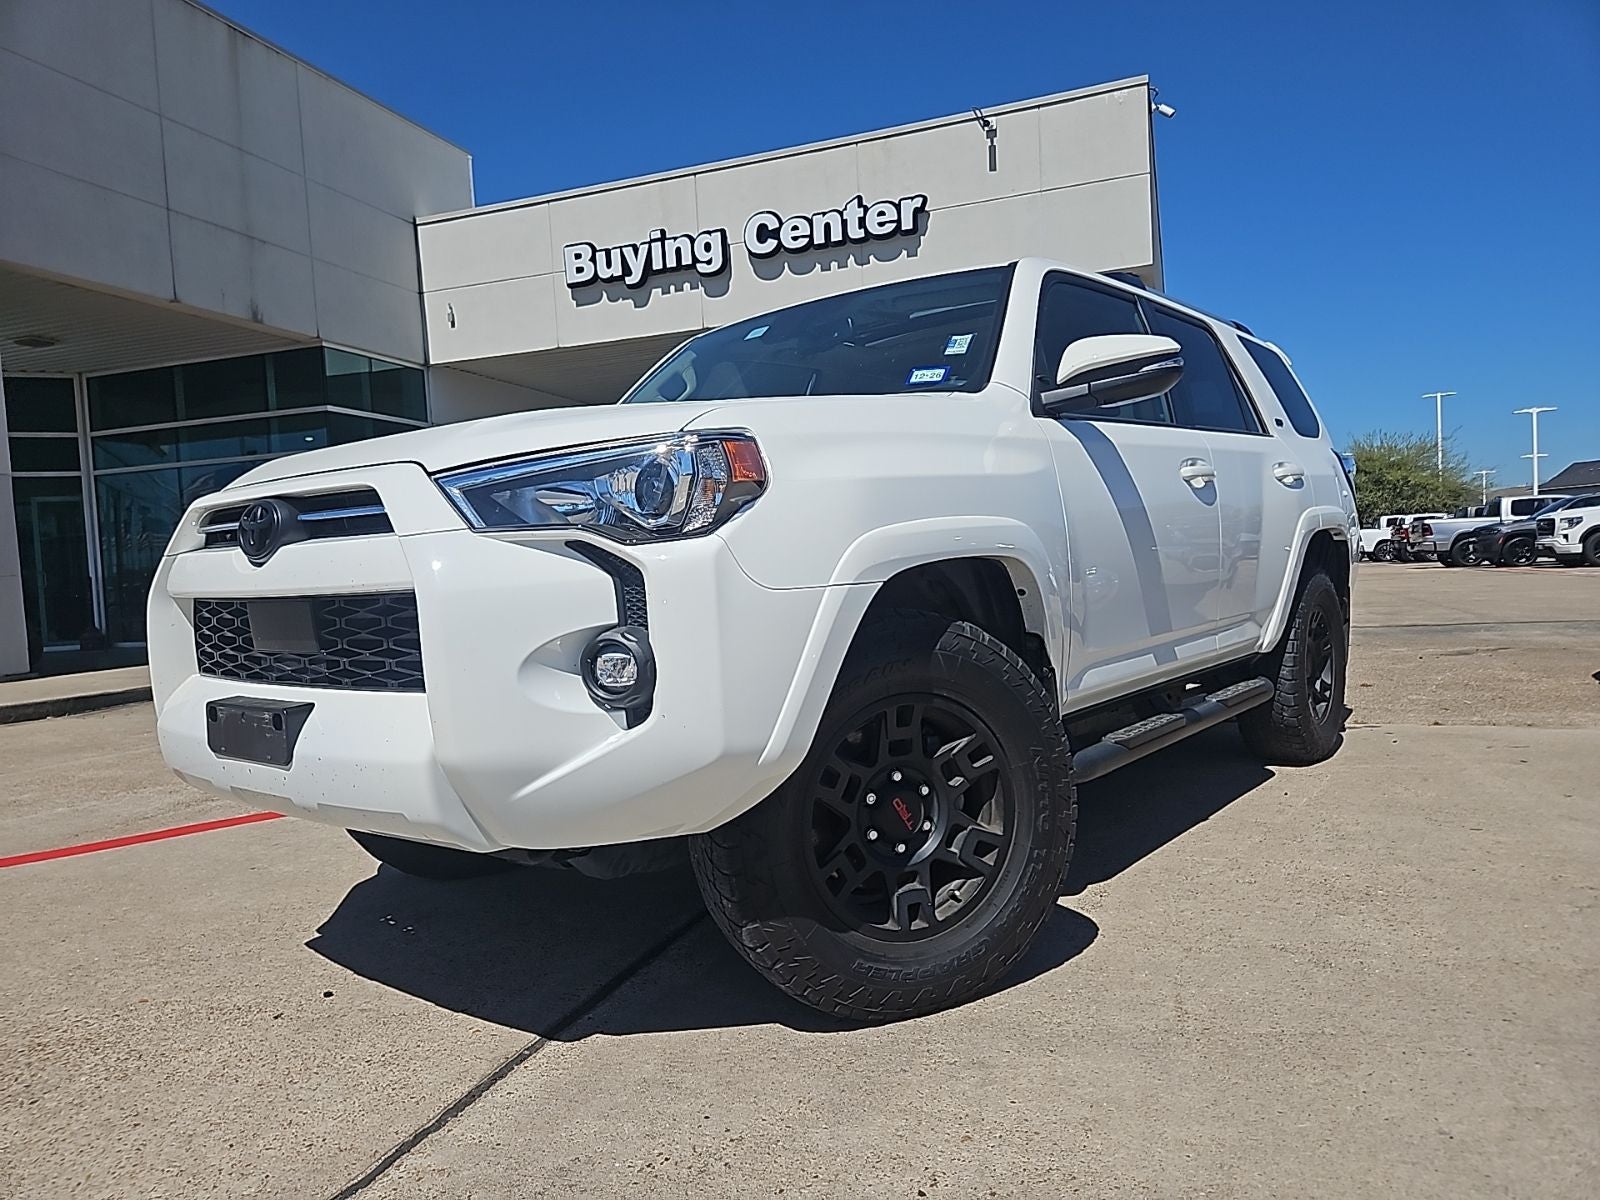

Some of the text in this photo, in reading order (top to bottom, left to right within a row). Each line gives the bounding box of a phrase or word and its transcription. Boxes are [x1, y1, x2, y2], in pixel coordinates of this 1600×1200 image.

[565, 195, 926, 288] Buying Center
[892, 797, 913, 831] TRD
